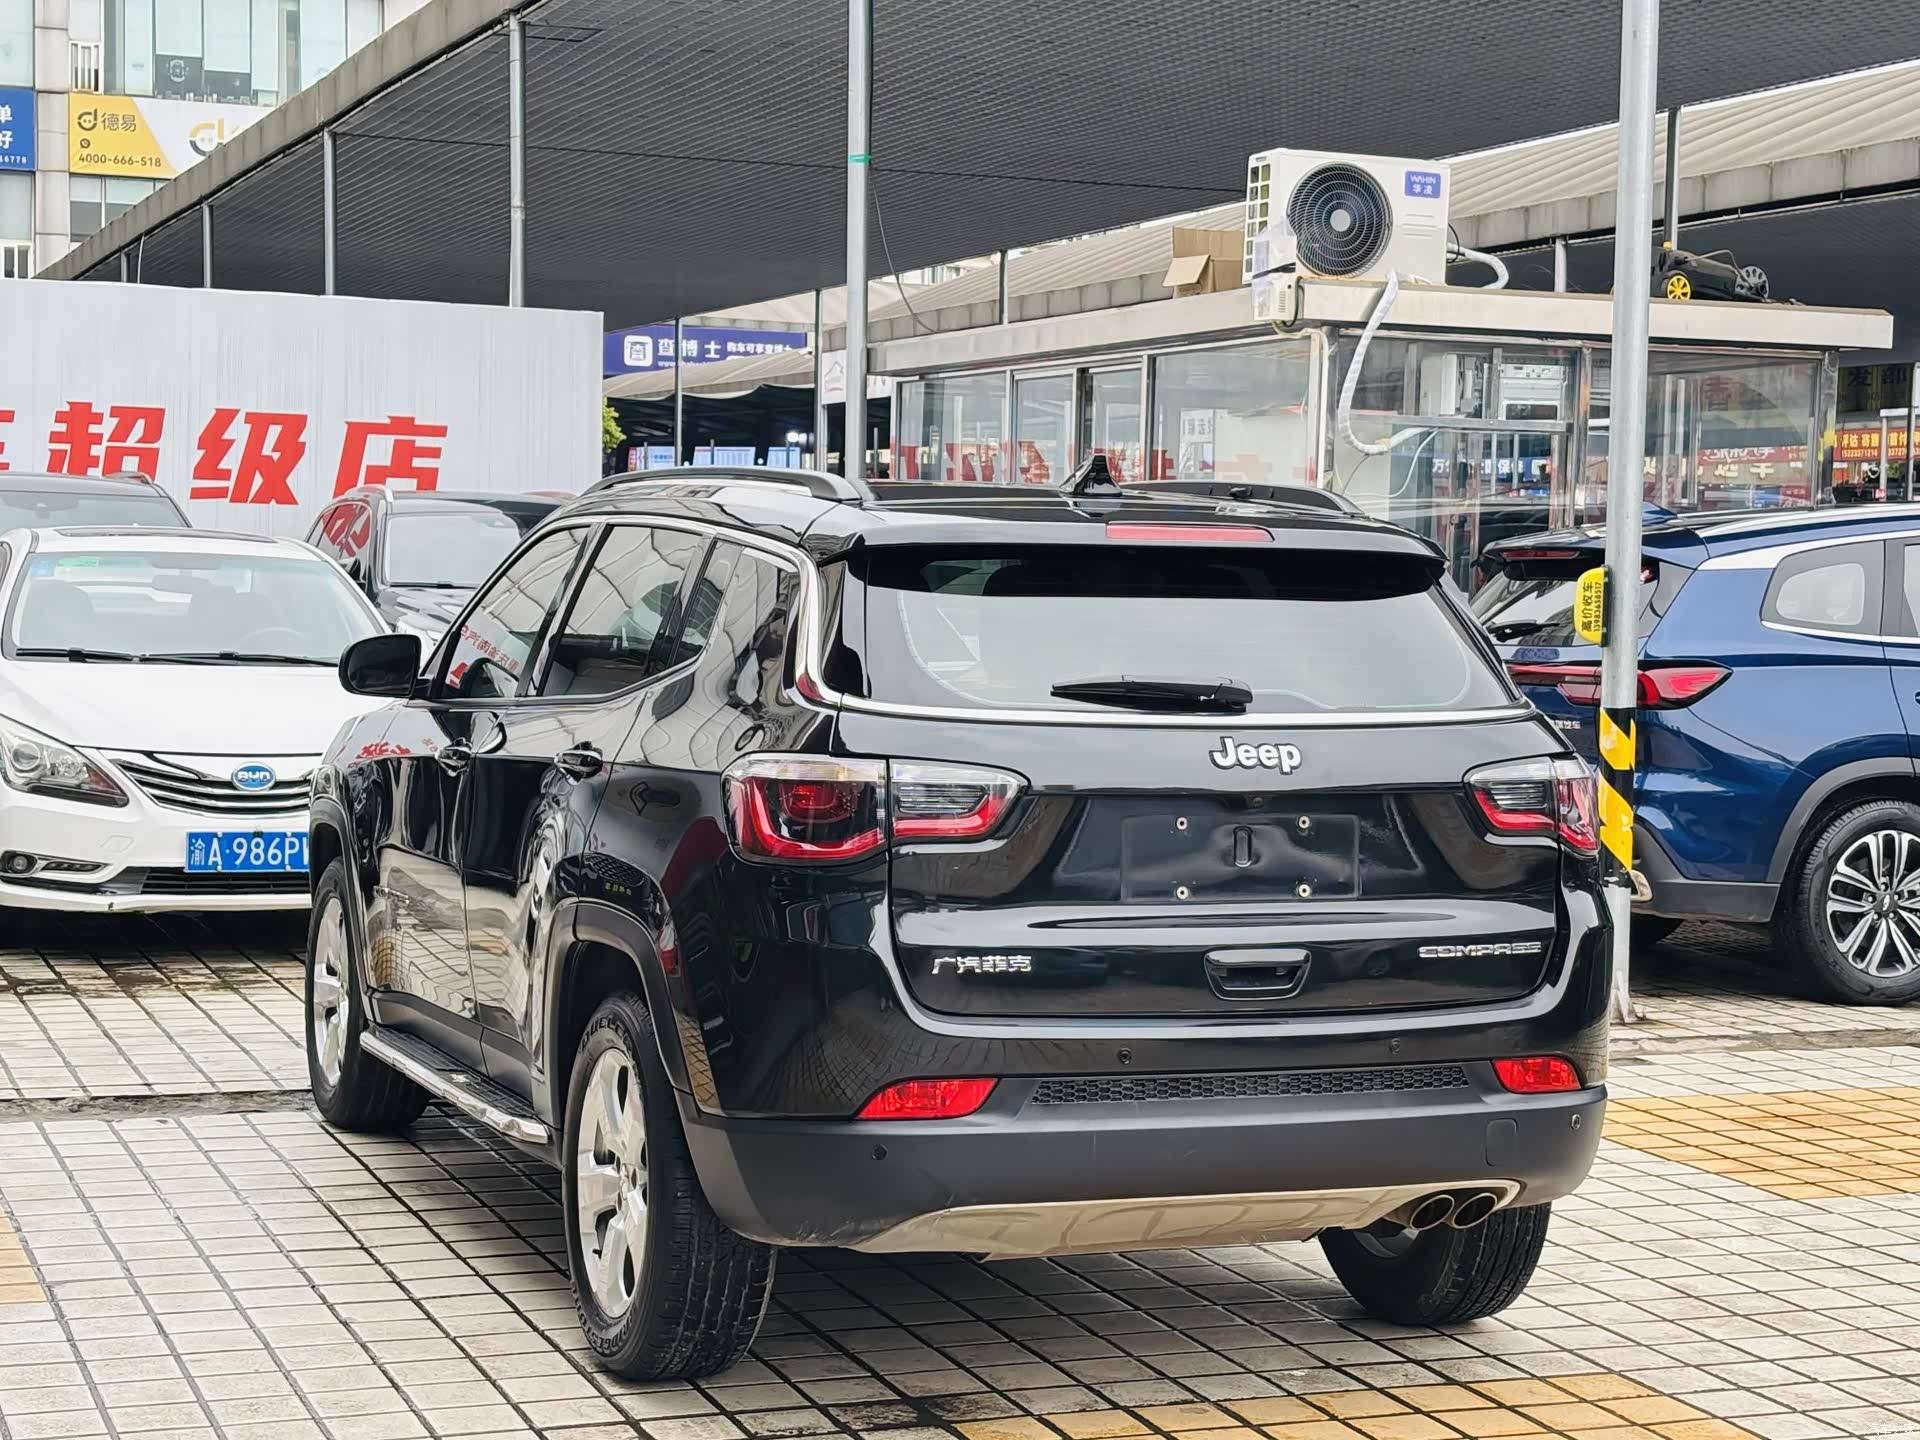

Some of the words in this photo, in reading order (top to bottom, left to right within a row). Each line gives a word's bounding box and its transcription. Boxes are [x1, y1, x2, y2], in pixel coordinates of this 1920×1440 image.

[101, 113, 136, 132] 德易
[78, 154, 161, 167] 4000-666-518
[657, 338, 721, 357] 查博士
[1581, 582, 1594, 632] 高价收车
[1209, 736, 1302, 775] Jeep
[238, 770, 271, 782] BYD
[1418, 941, 1542, 958] COMPASS
[931, 954, 1032, 975] 广汽菲克
